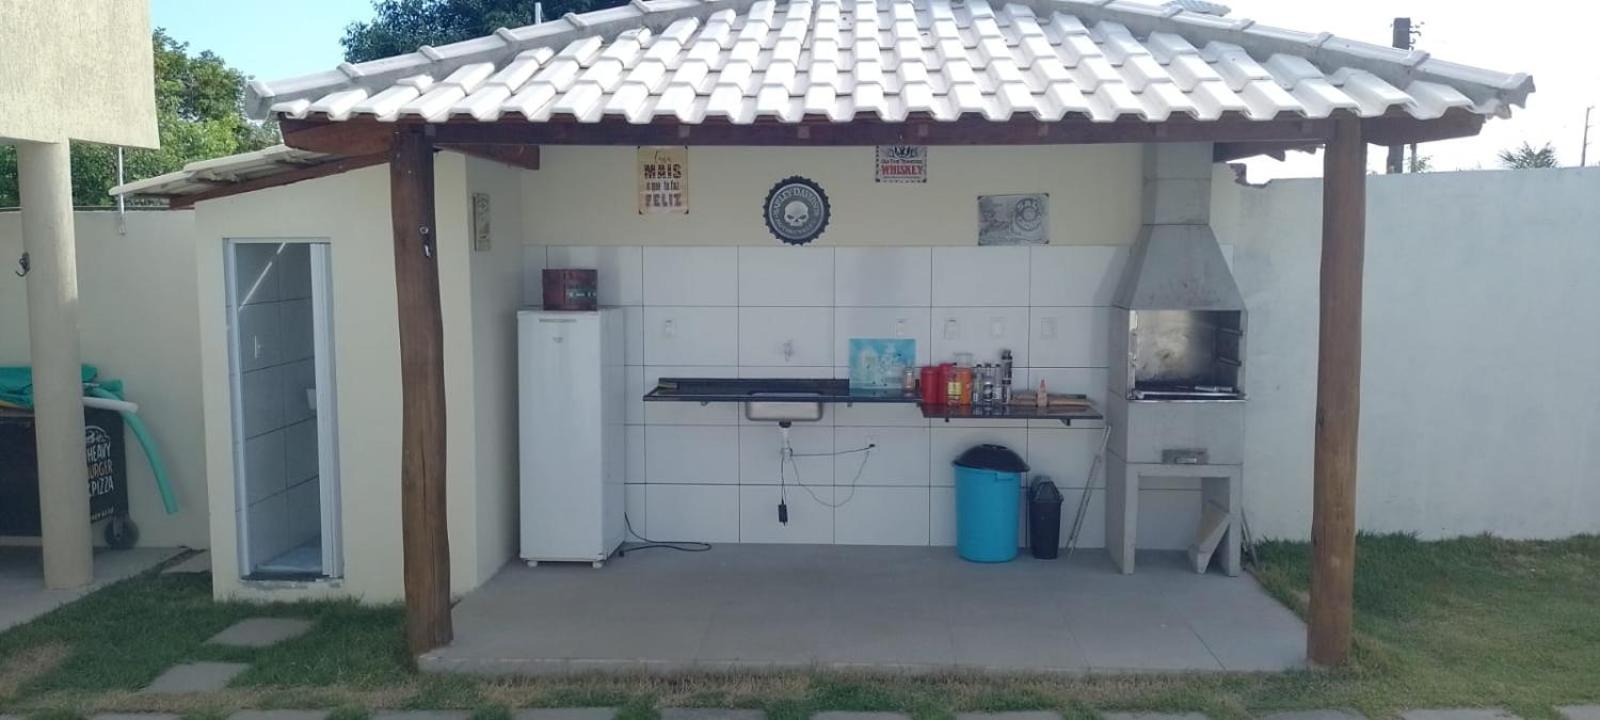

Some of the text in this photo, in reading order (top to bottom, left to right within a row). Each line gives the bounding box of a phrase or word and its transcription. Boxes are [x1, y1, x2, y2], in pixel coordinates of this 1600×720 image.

[644, 163, 682, 179] MAIS
[880, 164, 923, 176] WHISKEY
[645, 193, 682, 207] FELIZ
[87, 441, 111, 463] HEAVY
[88, 459, 113, 480] URGER
[91, 475, 114, 496] PIZZA
